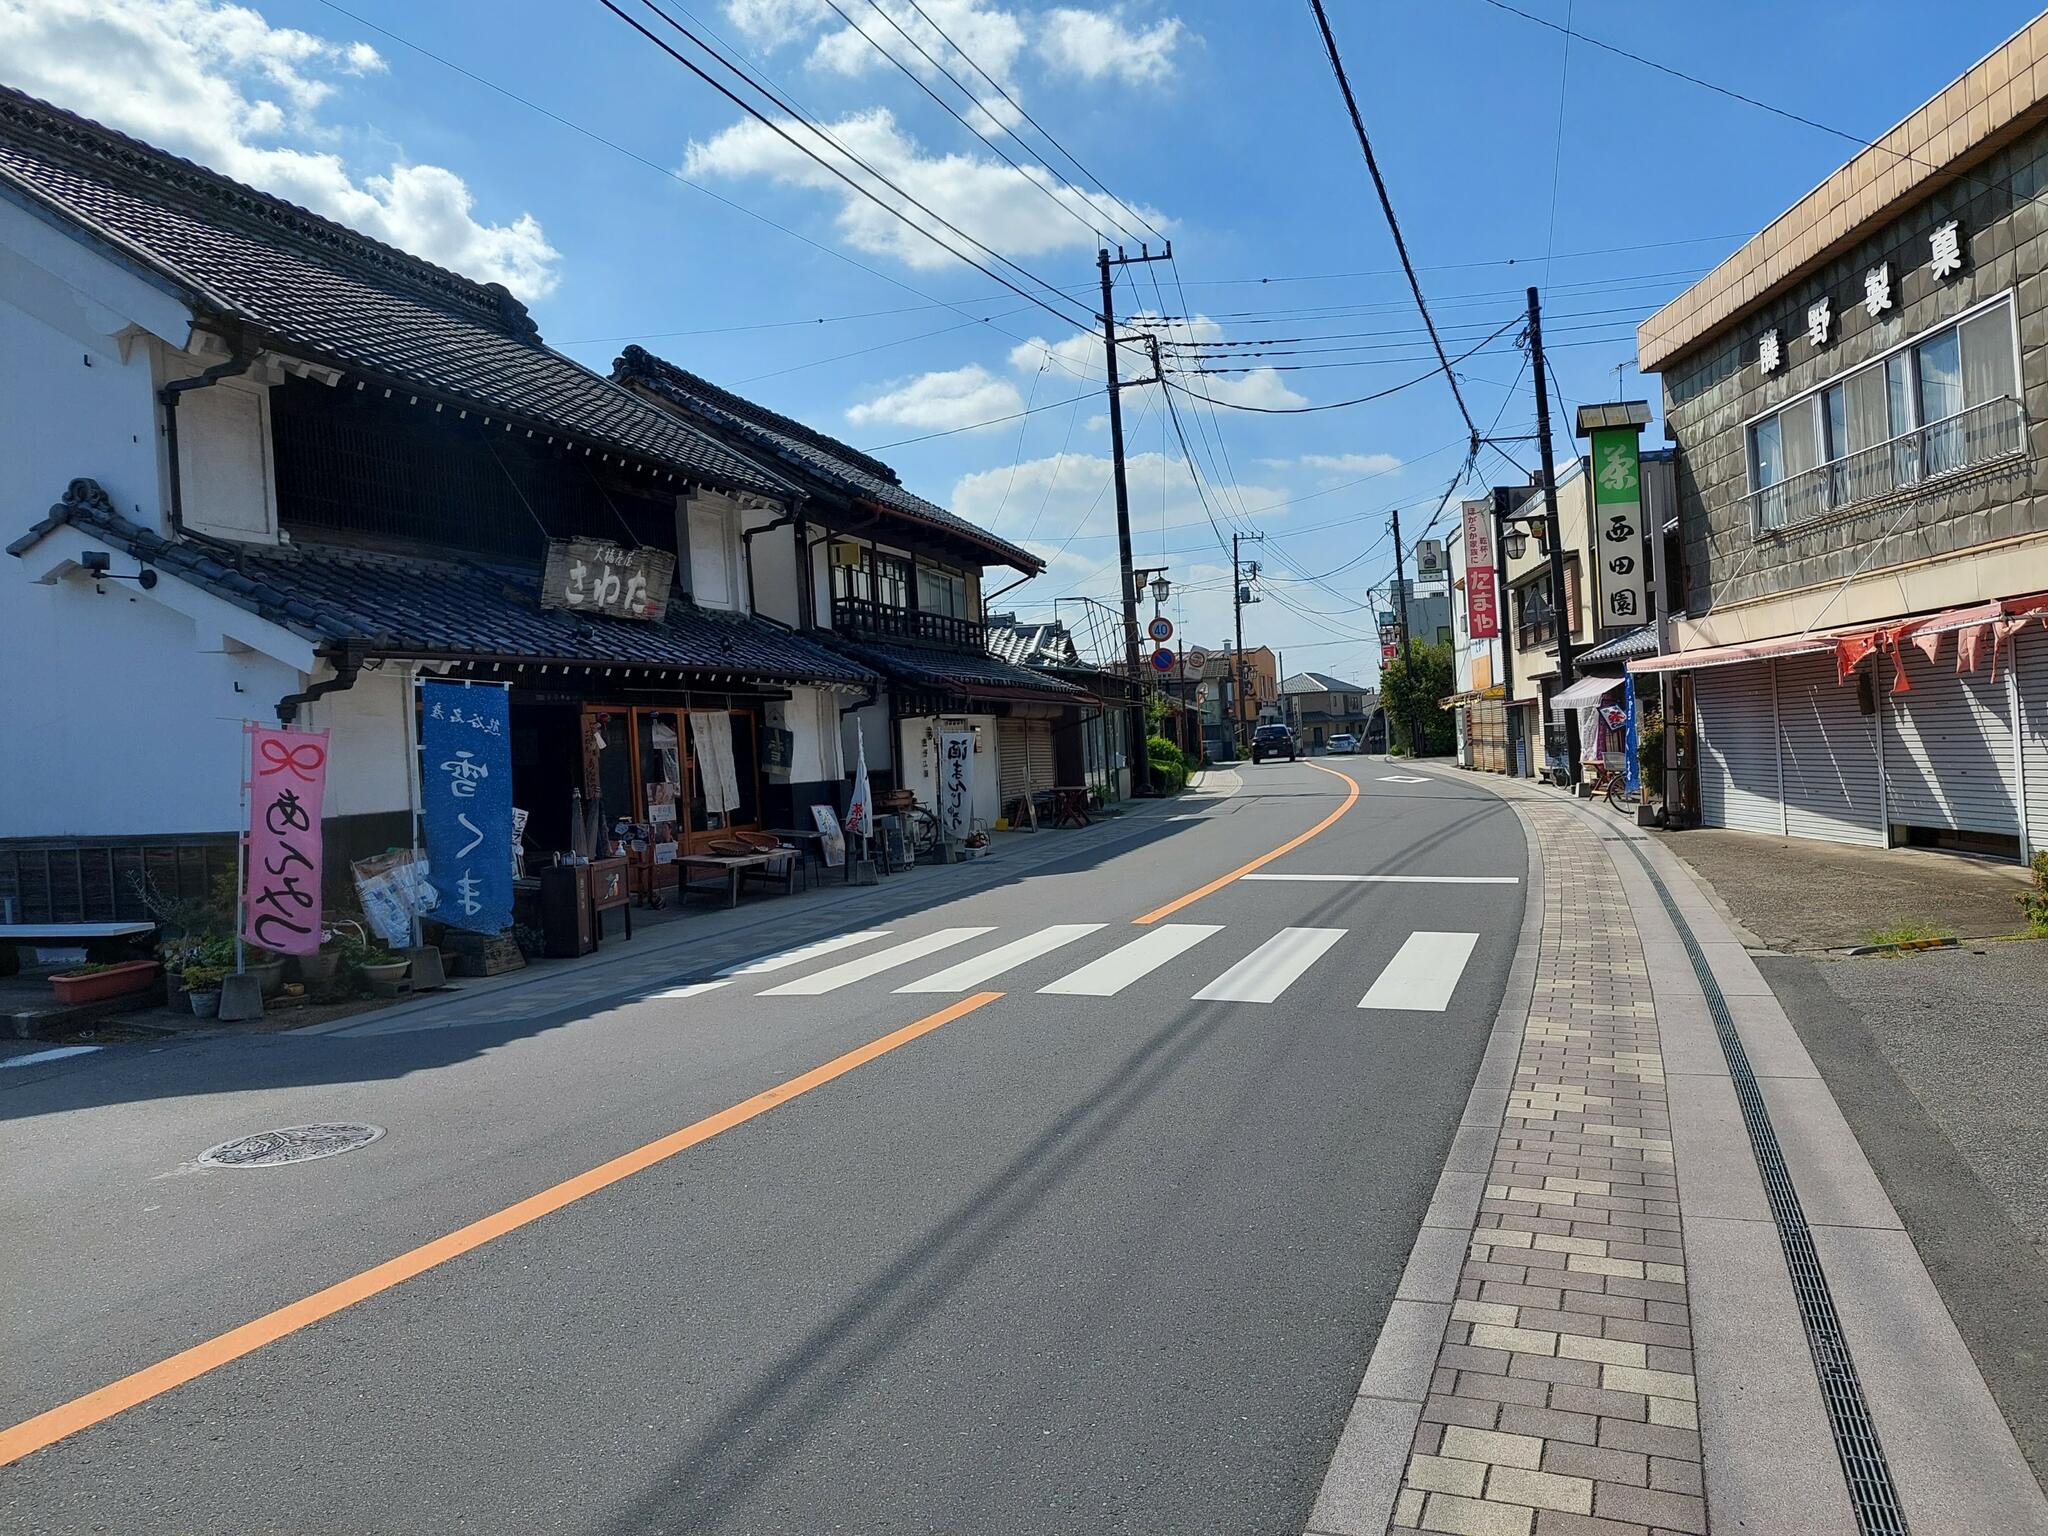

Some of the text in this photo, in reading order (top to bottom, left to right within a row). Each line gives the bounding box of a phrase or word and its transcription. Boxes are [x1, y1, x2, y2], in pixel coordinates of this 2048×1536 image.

[1758, 219, 1961, 376] 藤野製菓
[1599, 444, 1638, 490] 茶
[1467, 507, 1479, 564] ほがらか家族に
[565, 559, 647, 614] さわた
[1605, 515, 1637, 617] 西田園
[1153, 624, 1168, 636] 40
[1470, 571, 1494, 633] たまや
